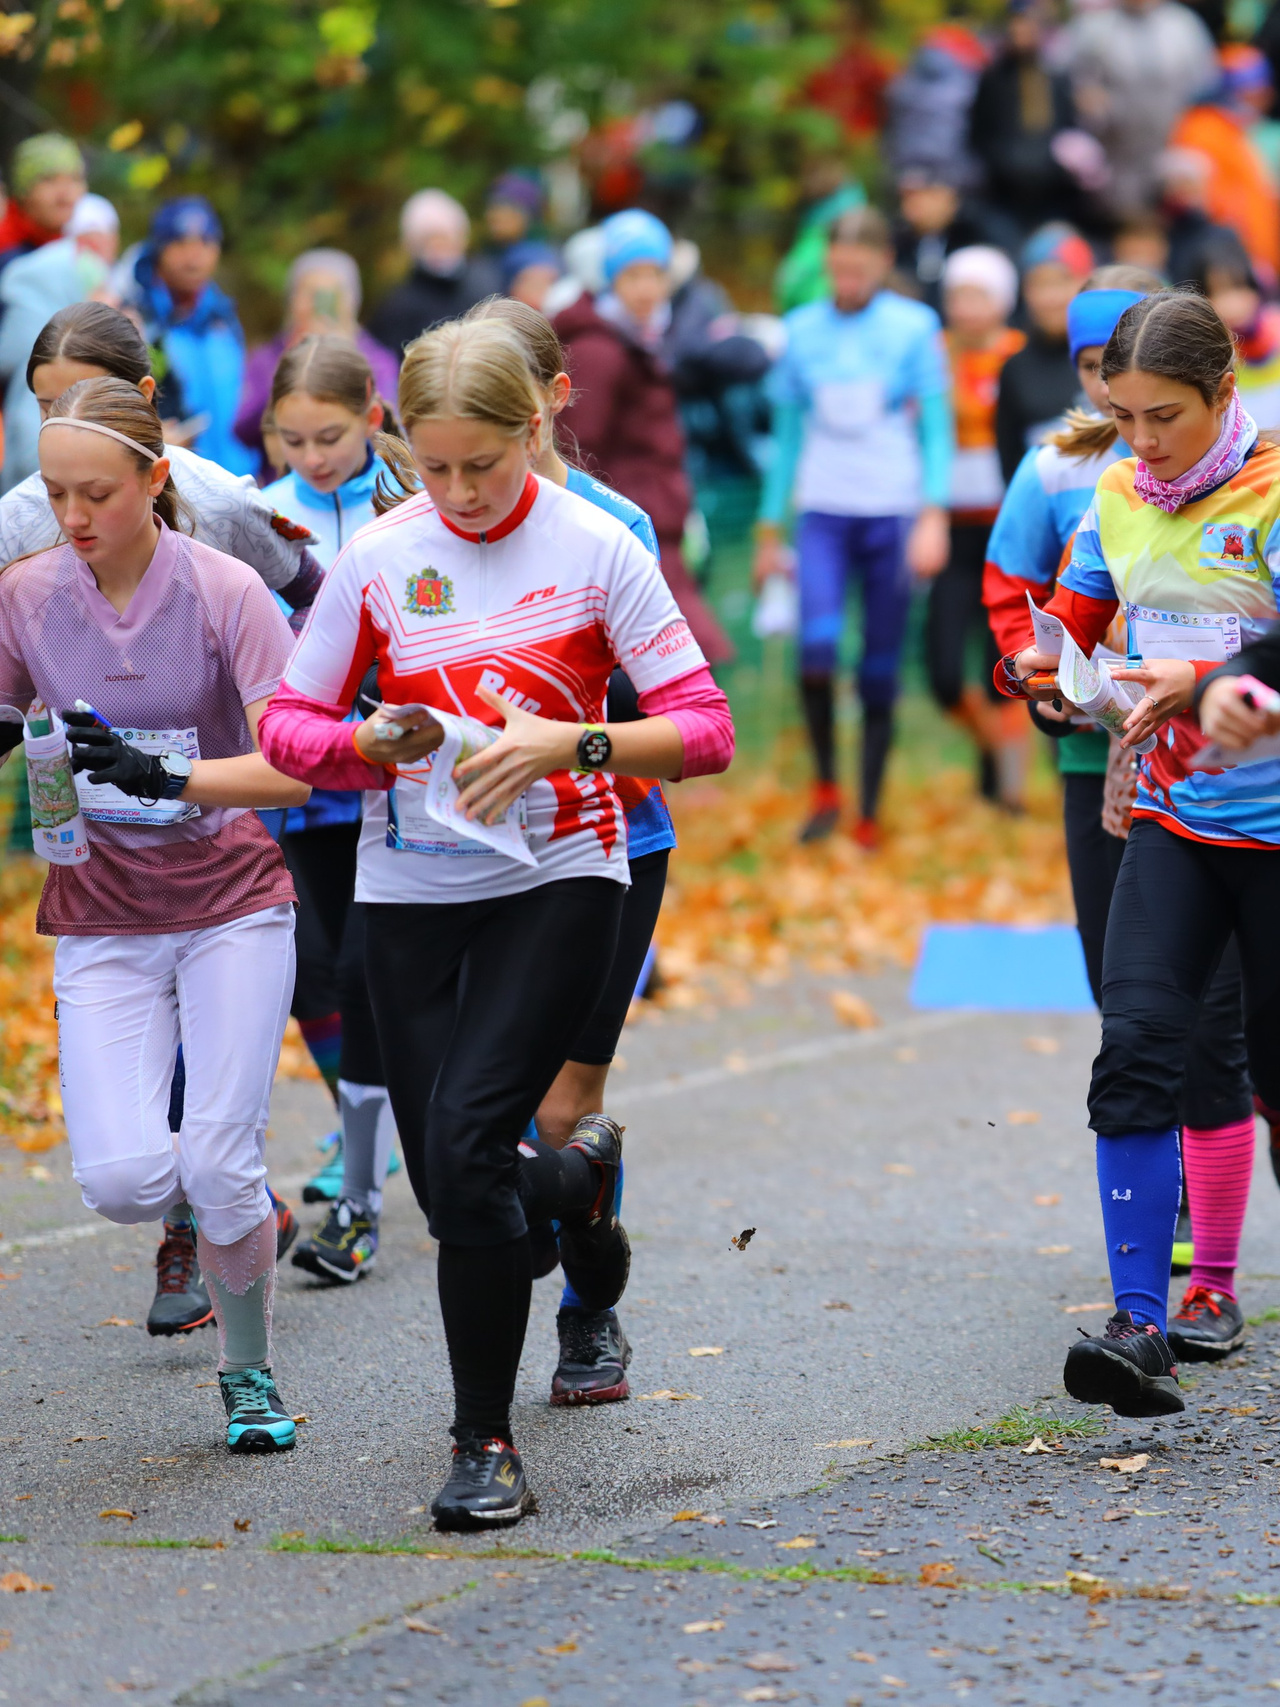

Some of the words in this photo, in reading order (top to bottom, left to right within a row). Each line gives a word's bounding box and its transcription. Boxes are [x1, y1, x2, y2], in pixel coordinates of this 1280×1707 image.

[474, 668, 542, 714] Run
[116, 809, 141, 817] РОССИИ
[74, 843, 88, 857] 83
